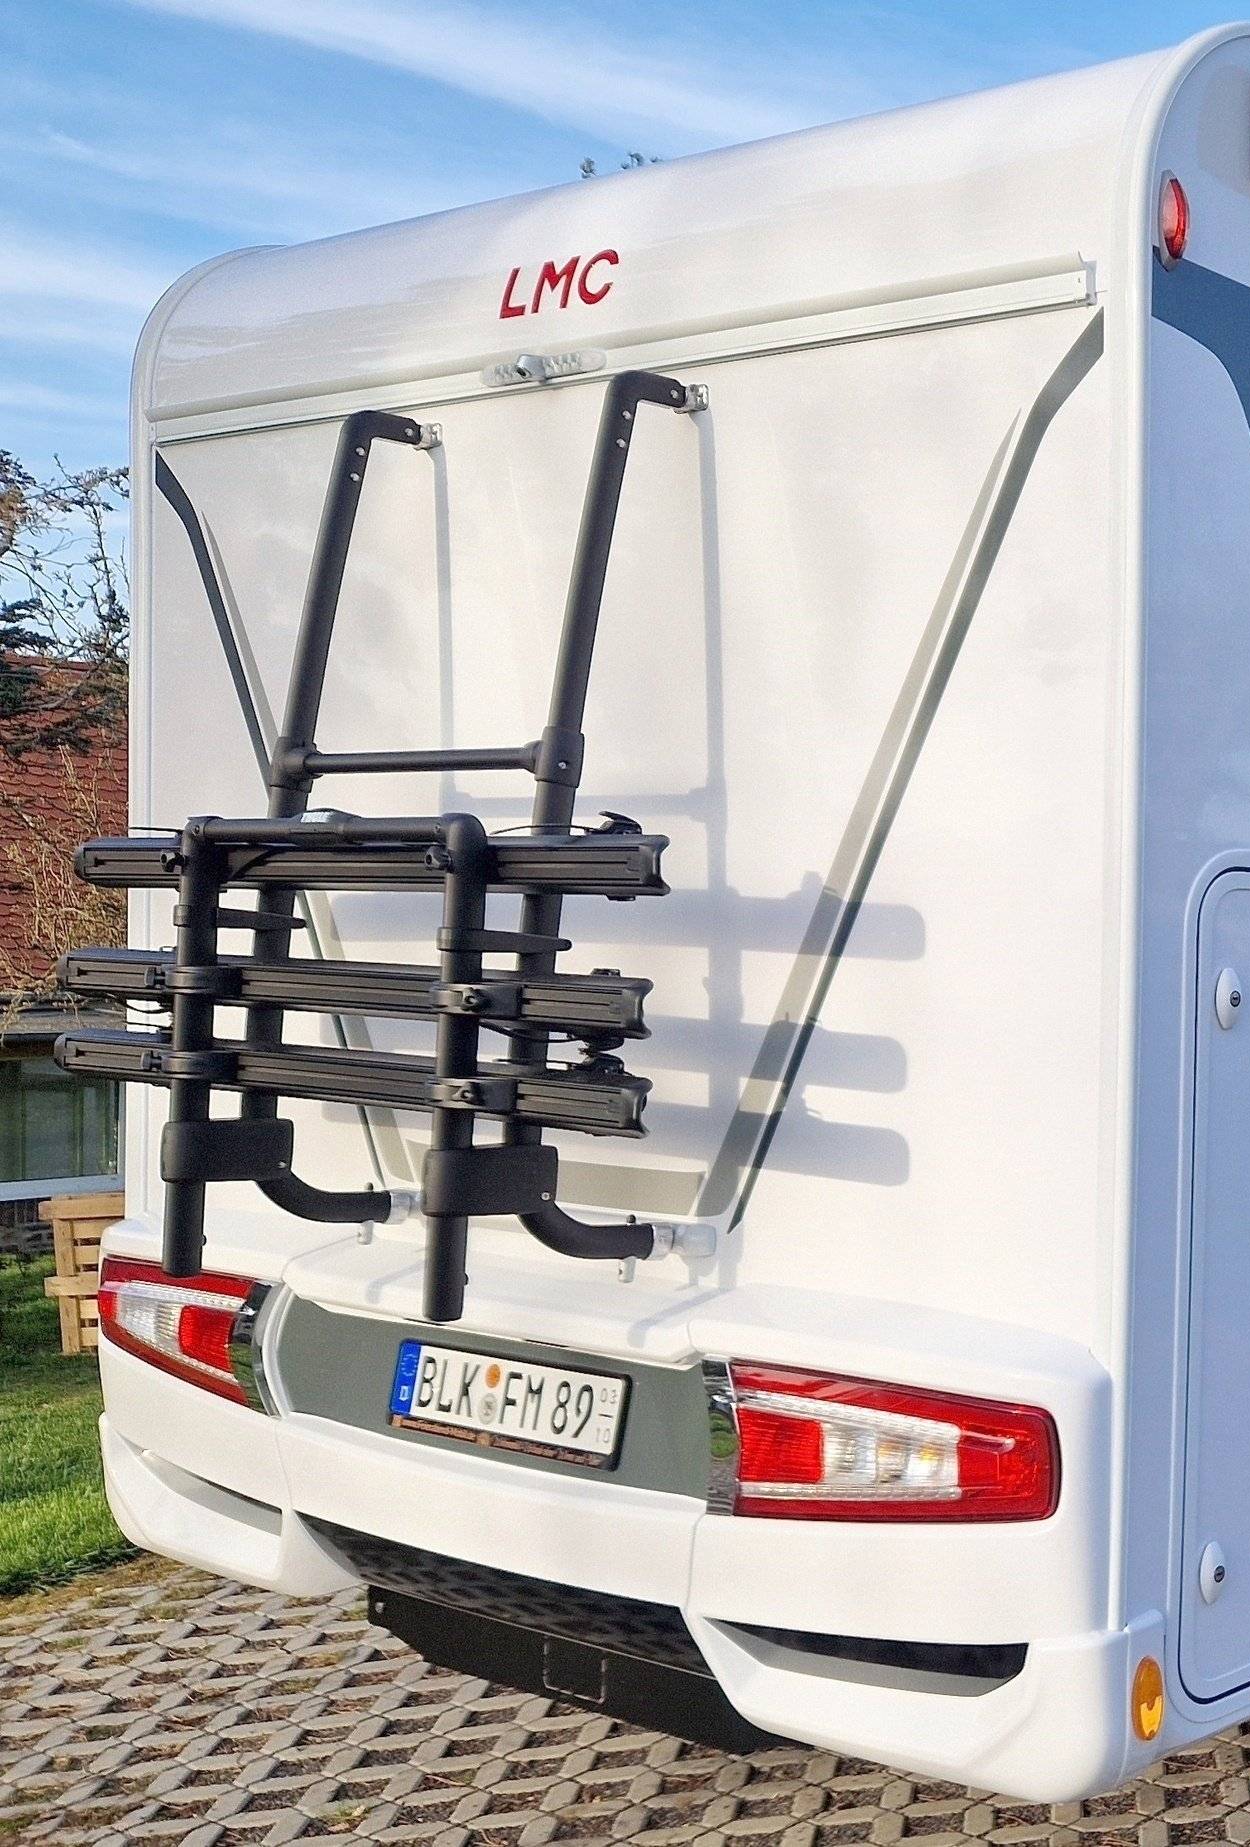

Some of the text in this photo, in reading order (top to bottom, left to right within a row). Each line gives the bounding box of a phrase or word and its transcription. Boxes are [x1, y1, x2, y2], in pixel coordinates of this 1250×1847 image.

[499, 249, 619, 319] LMC
[415, 1355, 481, 1418] BLK
[500, 1370, 545, 1432] FM
[550, 1379, 595, 1439] 89
